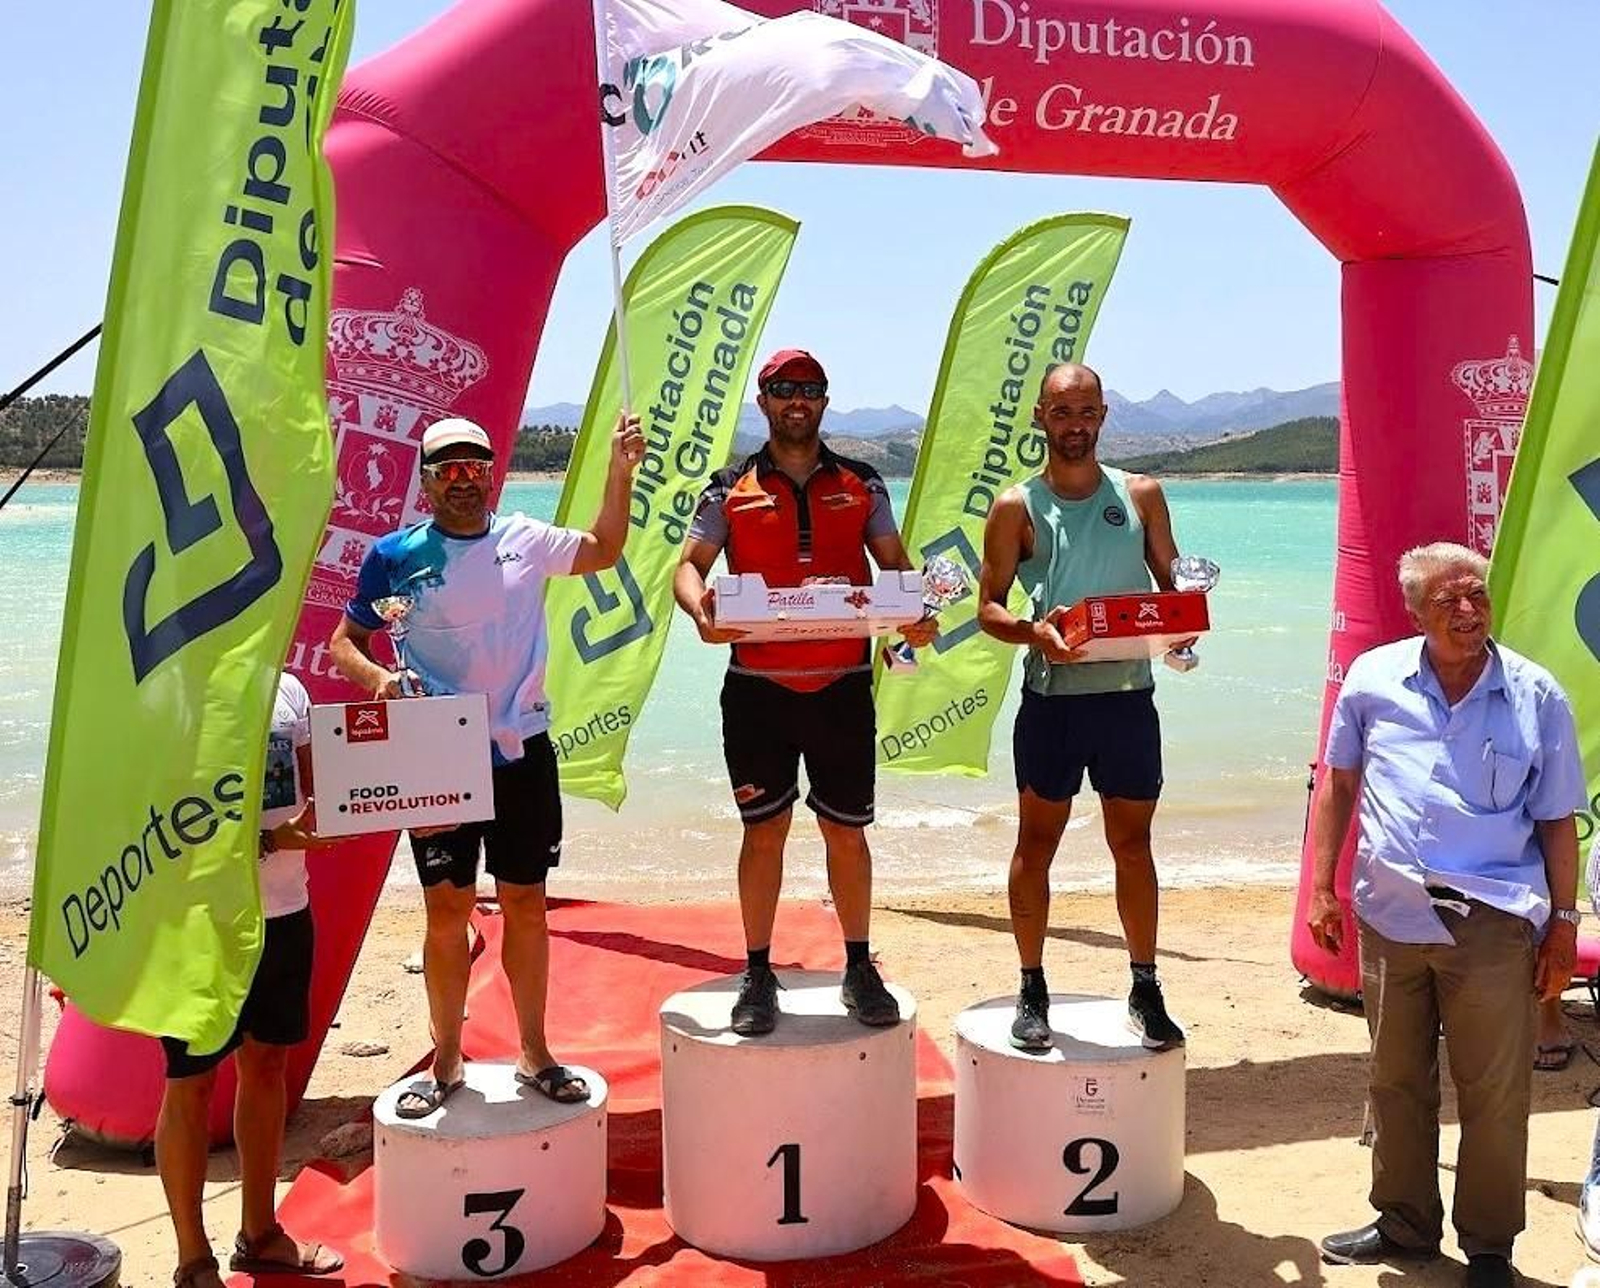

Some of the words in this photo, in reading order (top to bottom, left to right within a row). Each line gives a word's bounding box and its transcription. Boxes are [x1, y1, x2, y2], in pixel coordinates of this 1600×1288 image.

[969, 0, 1254, 67] Diputación
[1035, 83, 1239, 141] Granada
[675, 281, 758, 478] Granada
[963, 284, 1051, 519] Diputación
[658, 489, 695, 545] de
[880, 688, 988, 760] Deportes
[350, 785, 399, 801] FOOD
[350, 793, 460, 814] REVOLUTION
[62, 773, 244, 960] Deportes
[767, 1143, 809, 1225] 1
[1063, 1137, 1120, 1216] 2
[462, 1188, 525, 1276] 3
